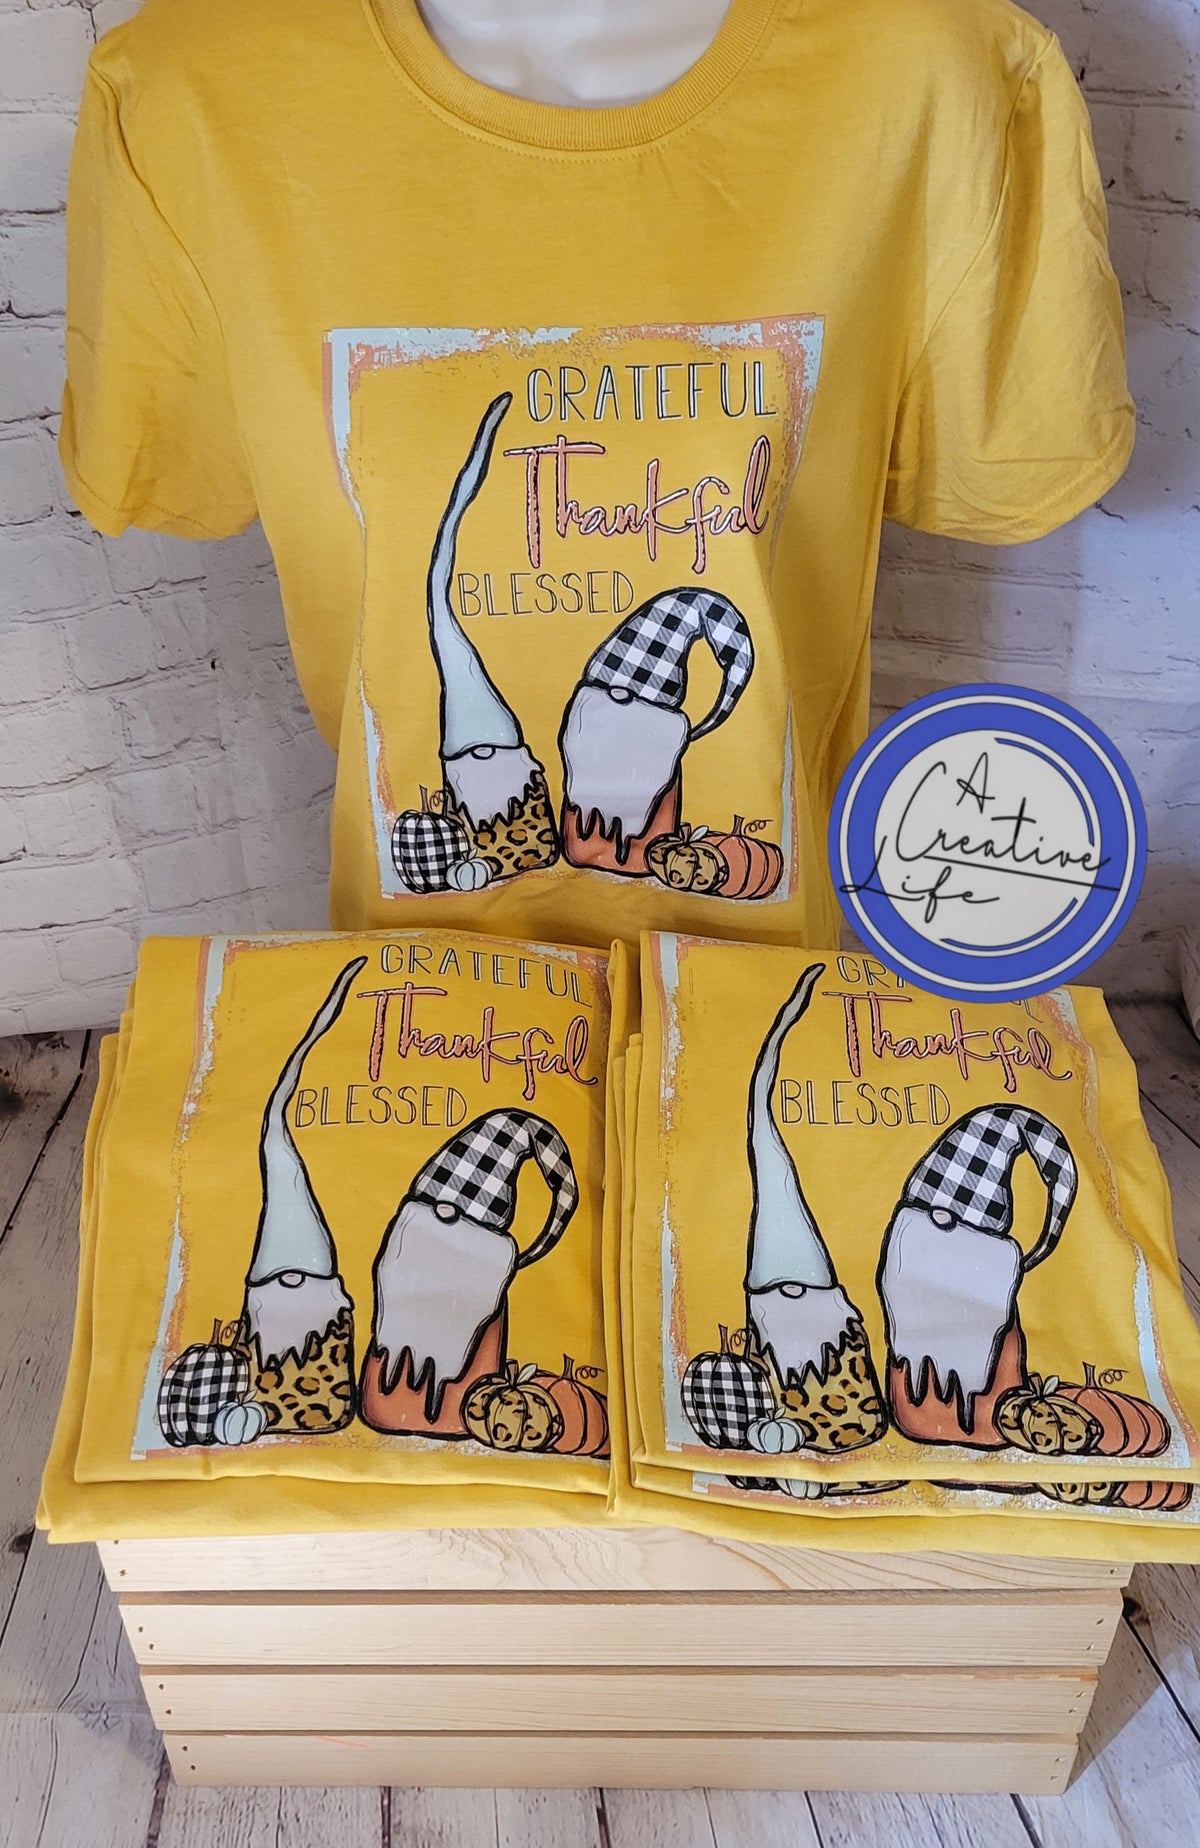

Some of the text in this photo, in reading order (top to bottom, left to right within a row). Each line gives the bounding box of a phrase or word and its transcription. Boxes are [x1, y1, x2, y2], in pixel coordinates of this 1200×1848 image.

[526, 361, 778, 422] GRATEFUL
[503, 434, 771, 574] Thankful
[457, 571, 635, 616] BLESSED
[381, 944, 593, 1008] GRATEFUL
[356, 981, 599, 1100] Thankful
[821, 991, 1073, 1093] Thankful
[295, 1085, 467, 1128] BLESSED
[780, 1079, 951, 1127] BLESSED
